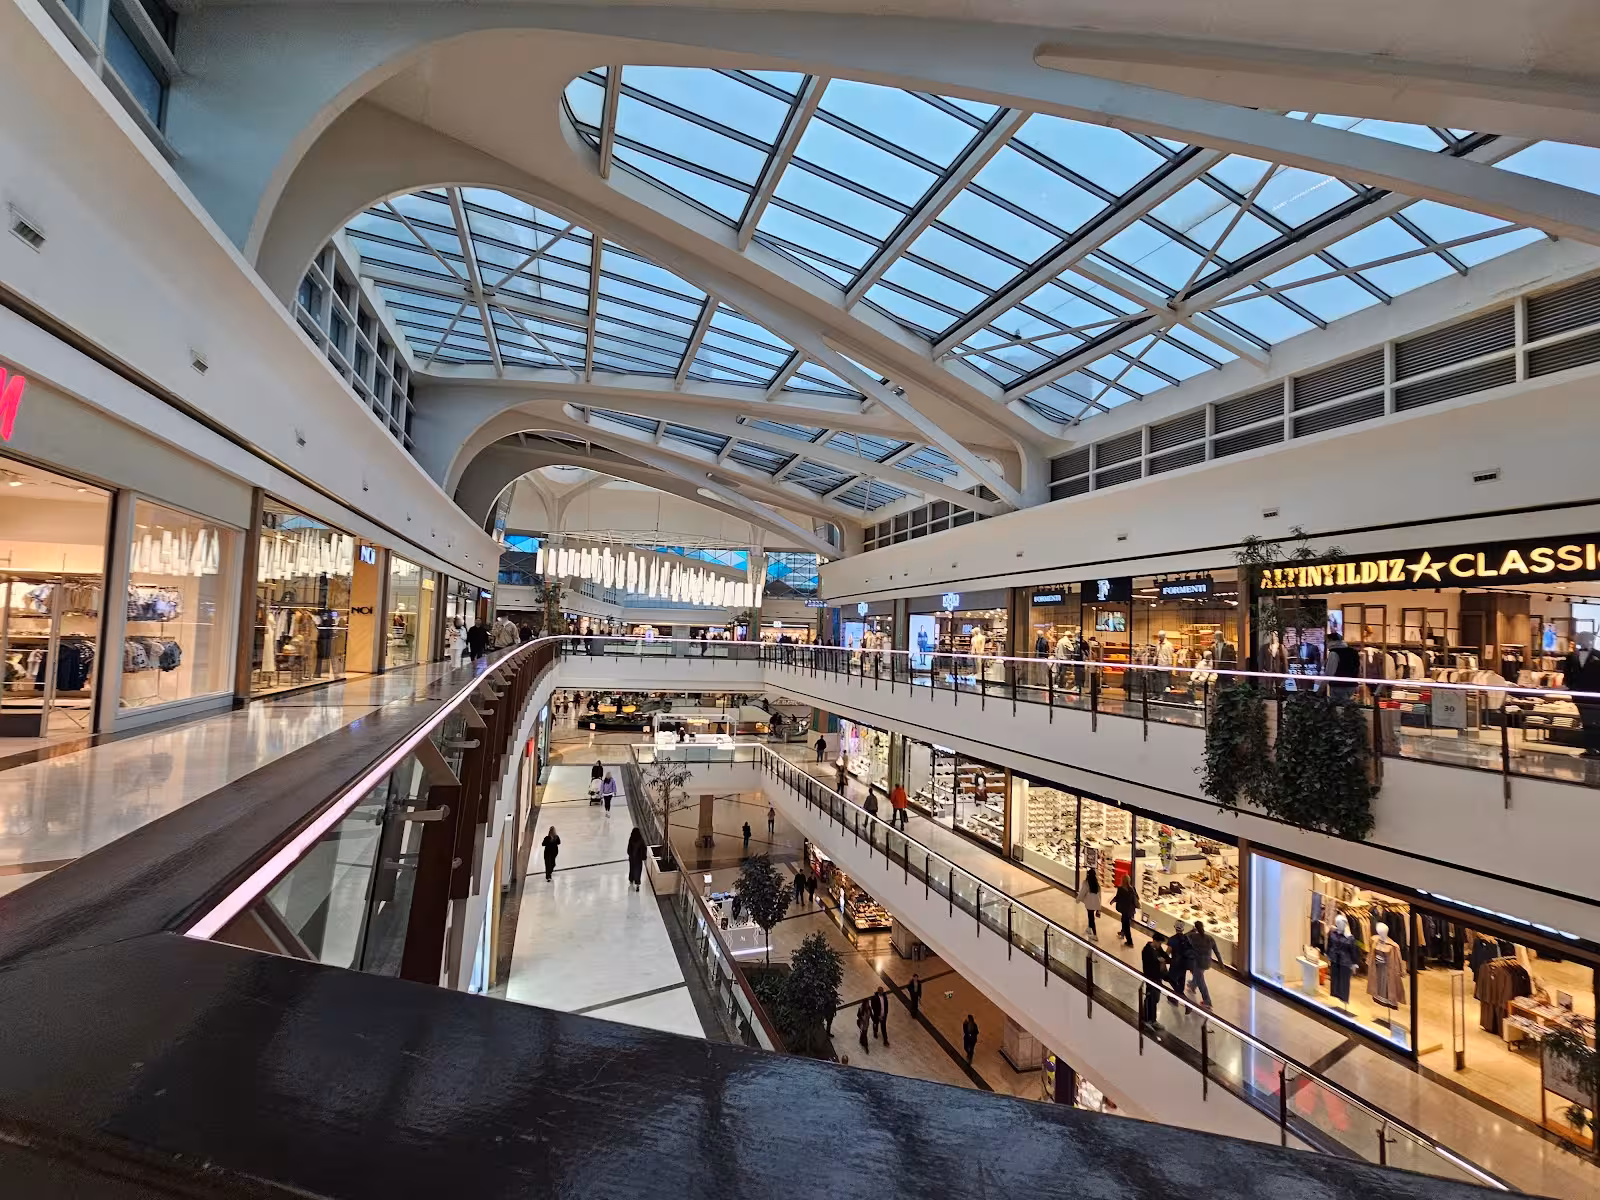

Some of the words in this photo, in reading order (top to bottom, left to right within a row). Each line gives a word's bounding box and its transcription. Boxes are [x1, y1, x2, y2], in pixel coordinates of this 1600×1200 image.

[1260, 558, 1406, 589] ALTINYILDIZ
[1449, 543, 1600, 577] CLASSI
[1162, 584, 1207, 595] FORMENTI
